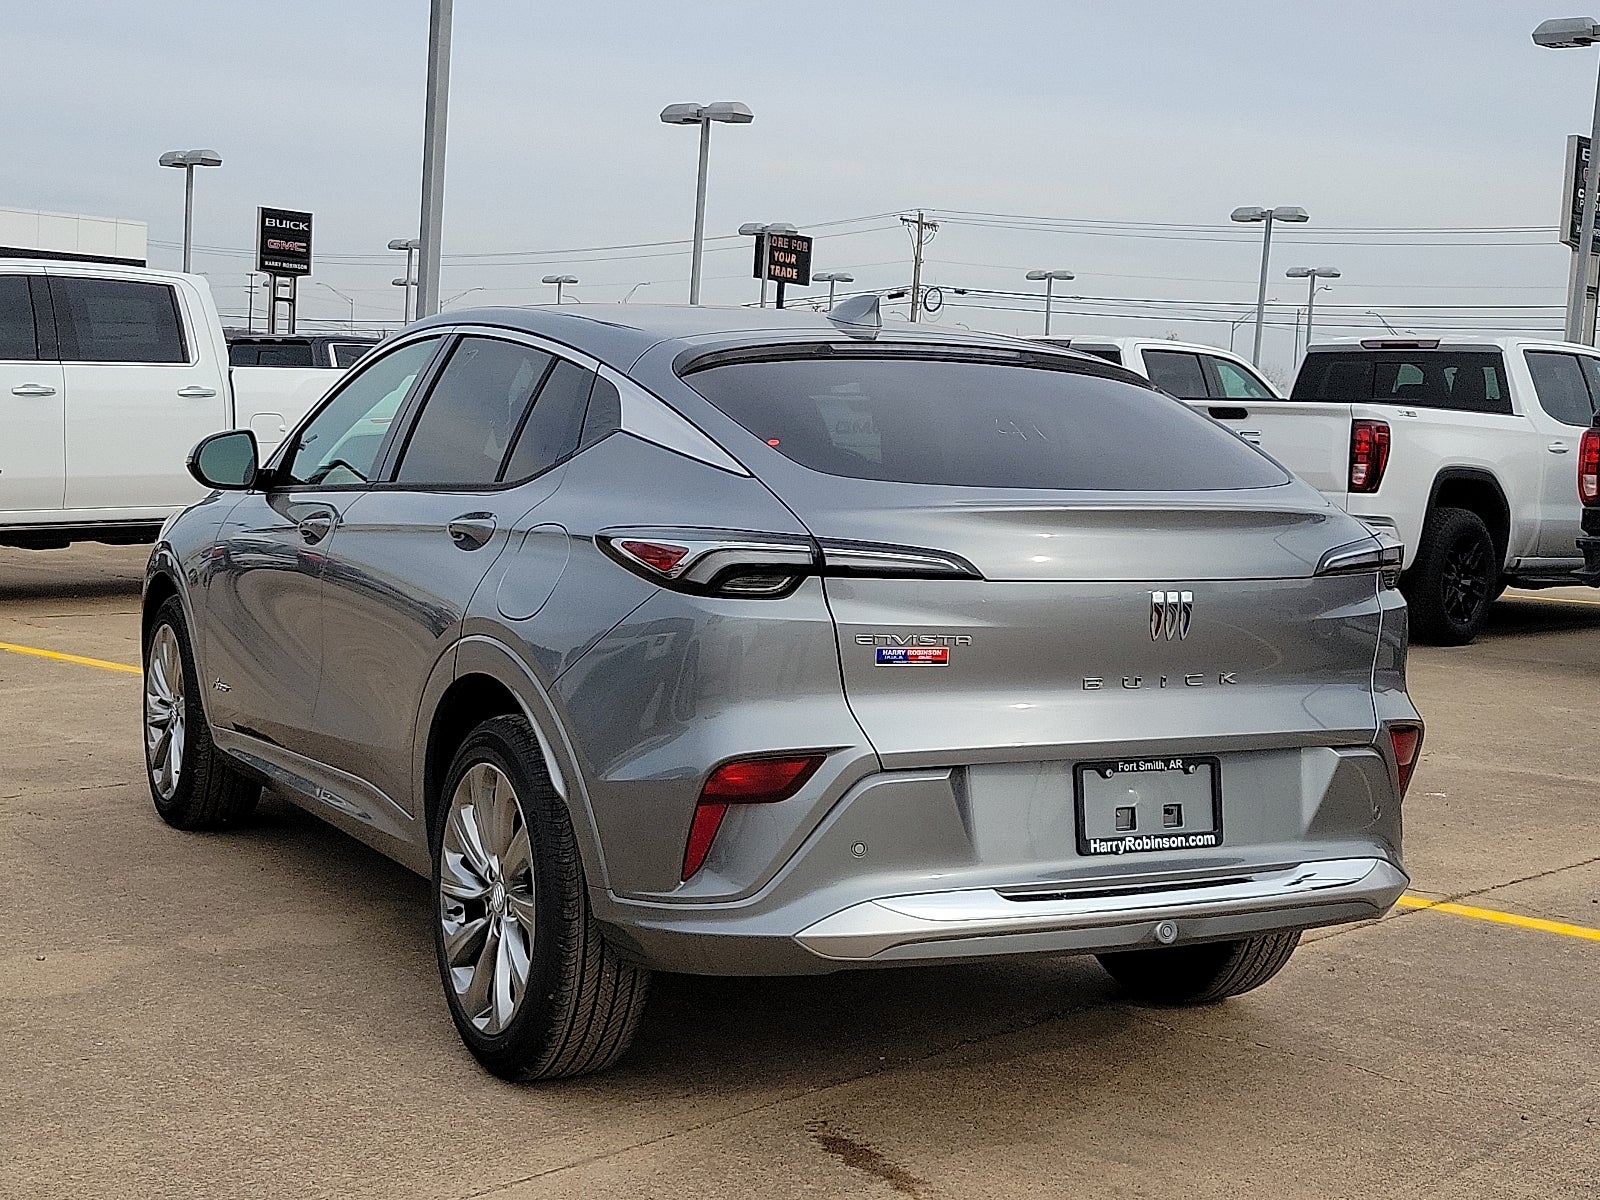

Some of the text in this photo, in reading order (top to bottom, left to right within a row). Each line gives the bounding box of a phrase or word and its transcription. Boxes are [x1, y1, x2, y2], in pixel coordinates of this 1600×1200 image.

[265, 218, 309, 230] BUICK
[267, 239, 306, 252] GMC
[768, 236, 808, 252] ORE FOR
[774, 250, 797, 265] YOUR
[770, 264, 798, 279] TRADE
[1082, 672, 1237, 690] BUICK
[1118, 759, 1183, 772] Fort Smith, AR
[1090, 834, 1216, 854] HarryRobinson.com
